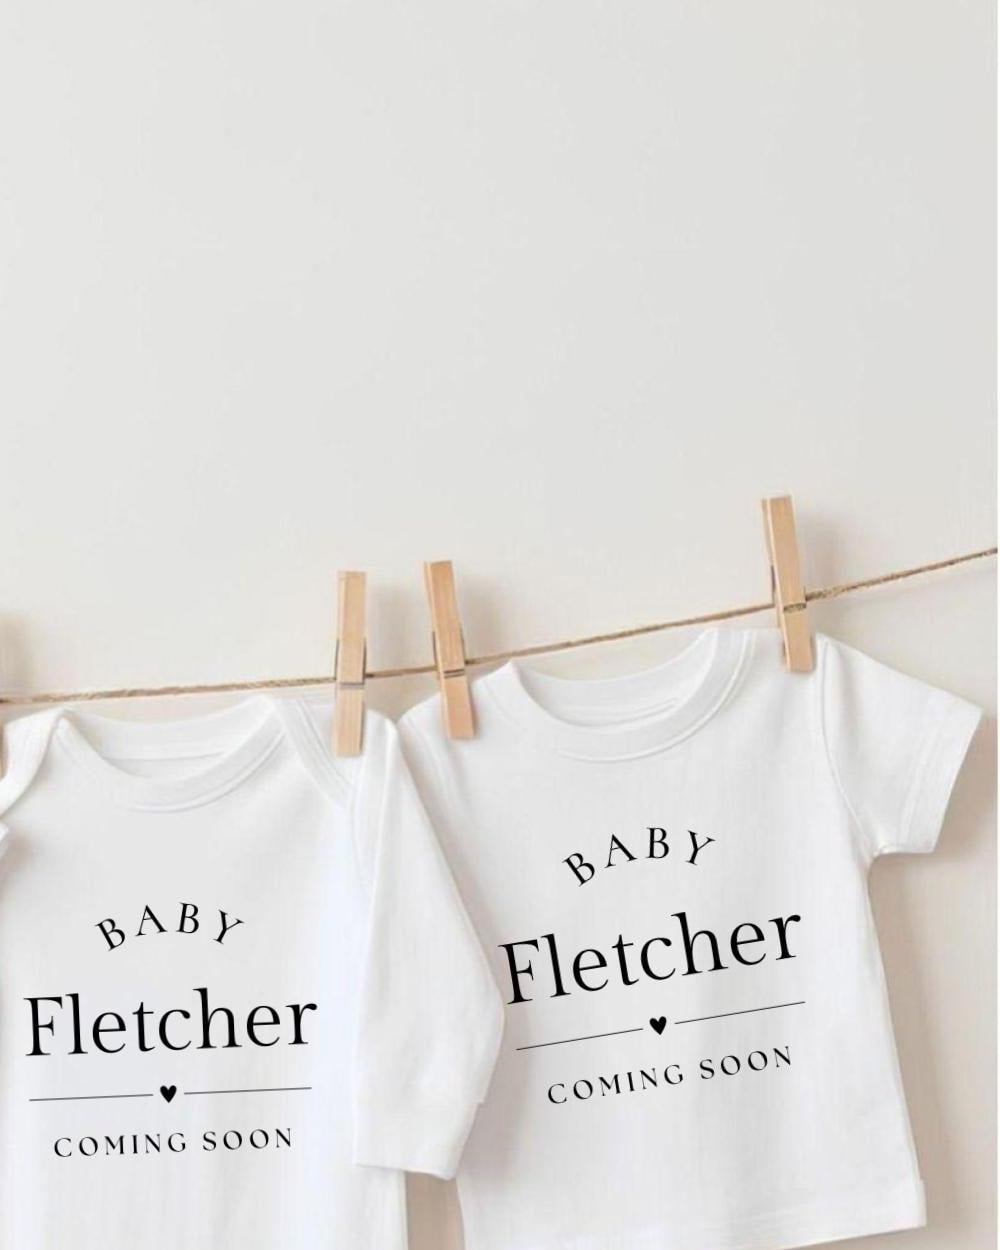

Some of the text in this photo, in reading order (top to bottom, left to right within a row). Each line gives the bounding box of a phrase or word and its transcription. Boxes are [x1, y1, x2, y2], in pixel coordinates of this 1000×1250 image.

[562, 827, 716, 887] BABY
[95, 903, 244, 951] BABY
[497, 911, 802, 1005] Fletcher
[24, 987, 317, 1056] Fletcher
[548, 1046, 790, 1104] COMING SOON
[54, 1128, 291, 1157] COMING SOON
